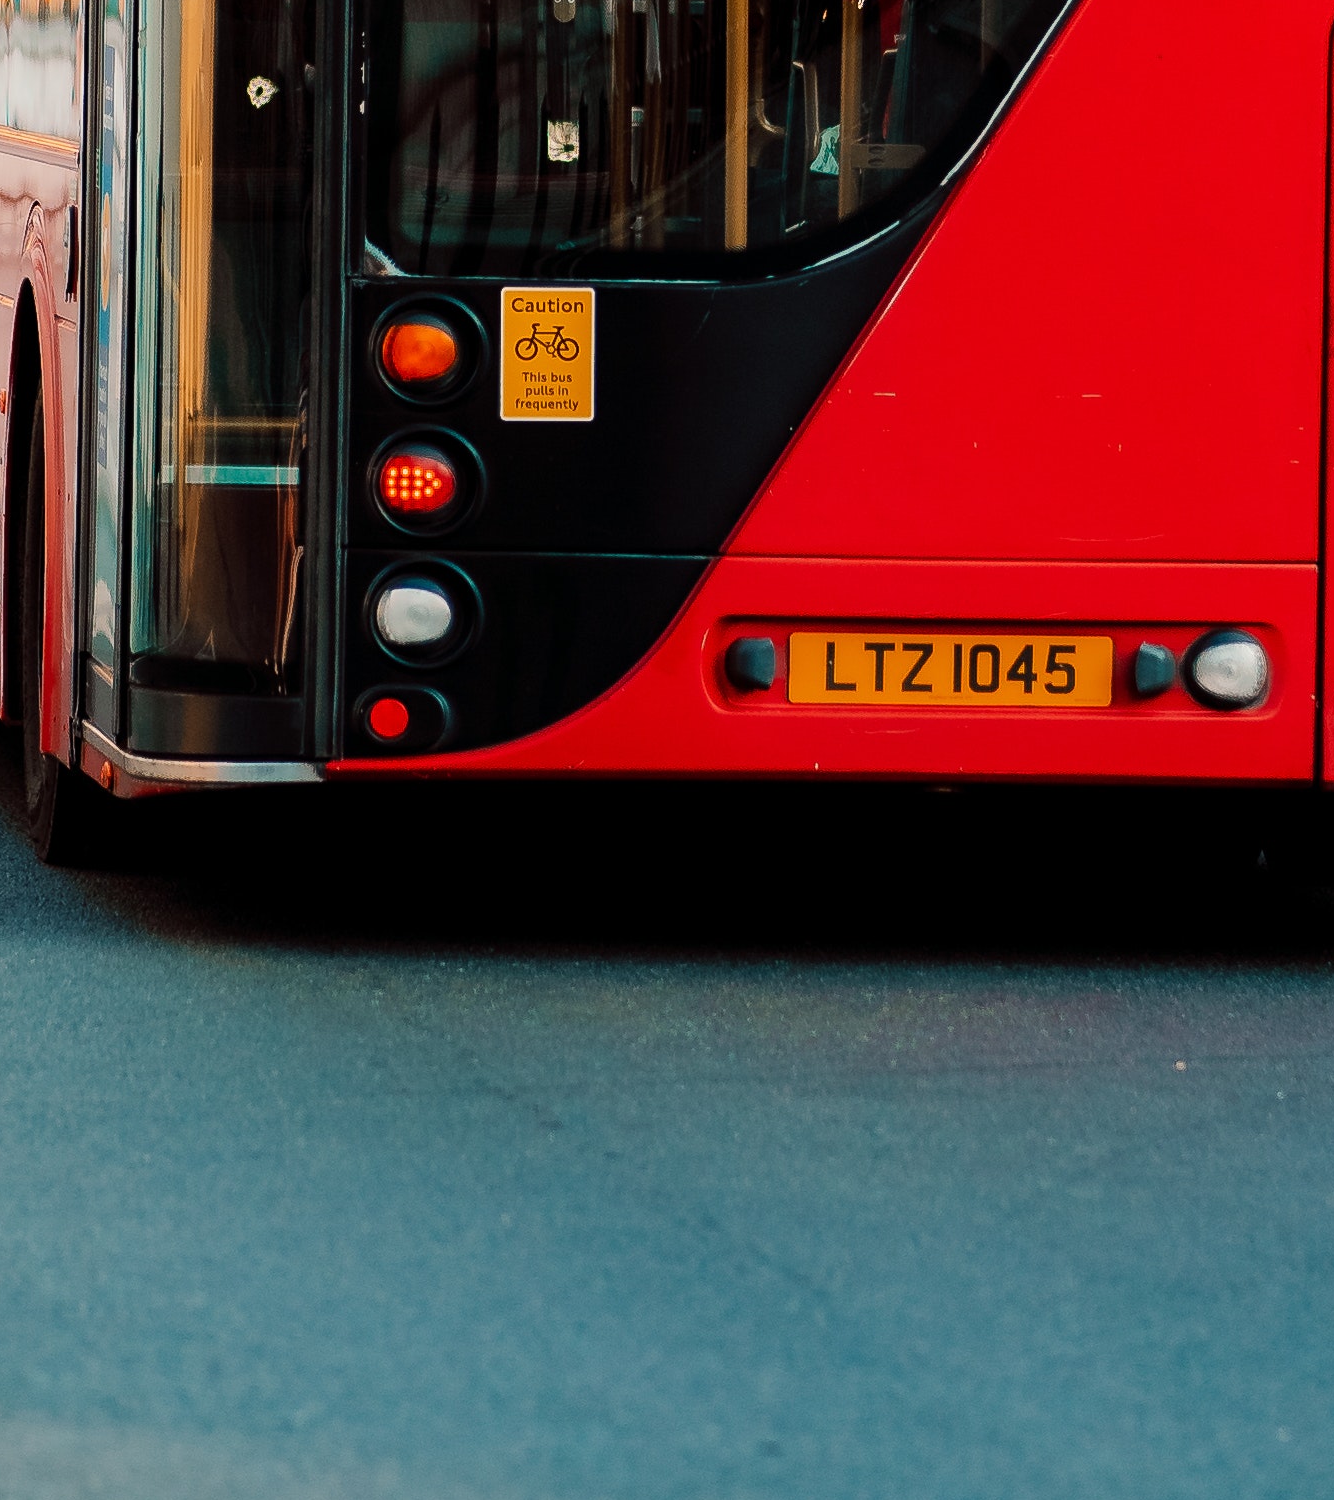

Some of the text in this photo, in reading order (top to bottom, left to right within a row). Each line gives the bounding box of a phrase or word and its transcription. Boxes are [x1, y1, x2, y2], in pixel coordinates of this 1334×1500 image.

[511, 297, 584, 313] Caution
[522, 371, 573, 382] This bus
[525, 385, 569, 398] pulls in
[515, 398, 579, 411] frequently
[825, 641, 1077, 695] LTZ 1045
